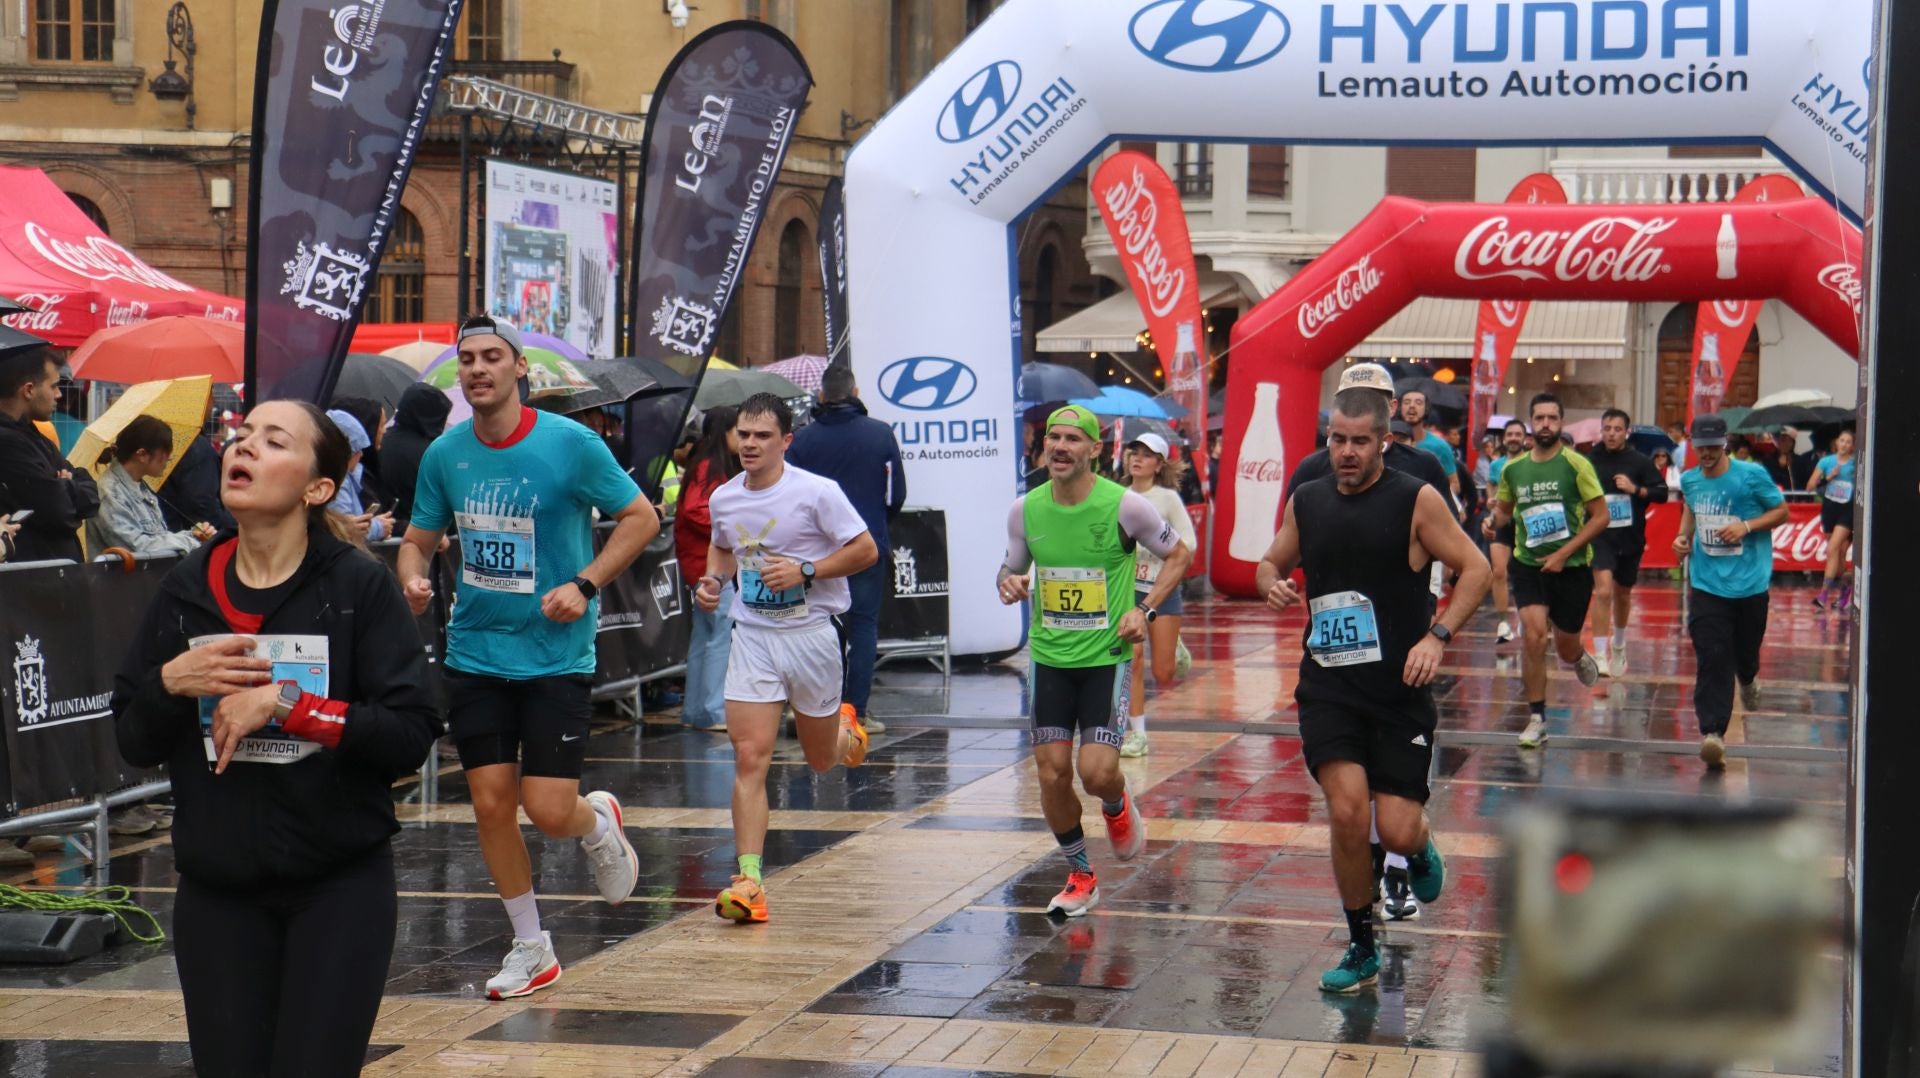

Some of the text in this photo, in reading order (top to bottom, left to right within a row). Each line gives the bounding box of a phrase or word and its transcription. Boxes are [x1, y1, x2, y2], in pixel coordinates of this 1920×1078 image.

[1319, 0, 1749, 63] HYUNDAI
[1318, 63, 1749, 98] Lemauto Automoción
[1790, 94, 1844, 142] Lemauto
[675, 94, 728, 194] León
[949, 76, 1077, 196] HYUNDAI
[968, 97, 1088, 207] Lemauto Automoción
[712, 106, 791, 307] AYUNTAMIENTO DE LEÓN
[918, 446, 999, 461] Automoción
[1532, 481, 1559, 491] aecc
[1532, 517, 1557, 536] 339
[473, 540, 516, 570] 338
[484, 577, 520, 587] HYUNDAI
[1060, 589, 1084, 612] 52
[1320, 616, 1359, 646] 645
[247, 741, 300, 755] HYUNDAI
